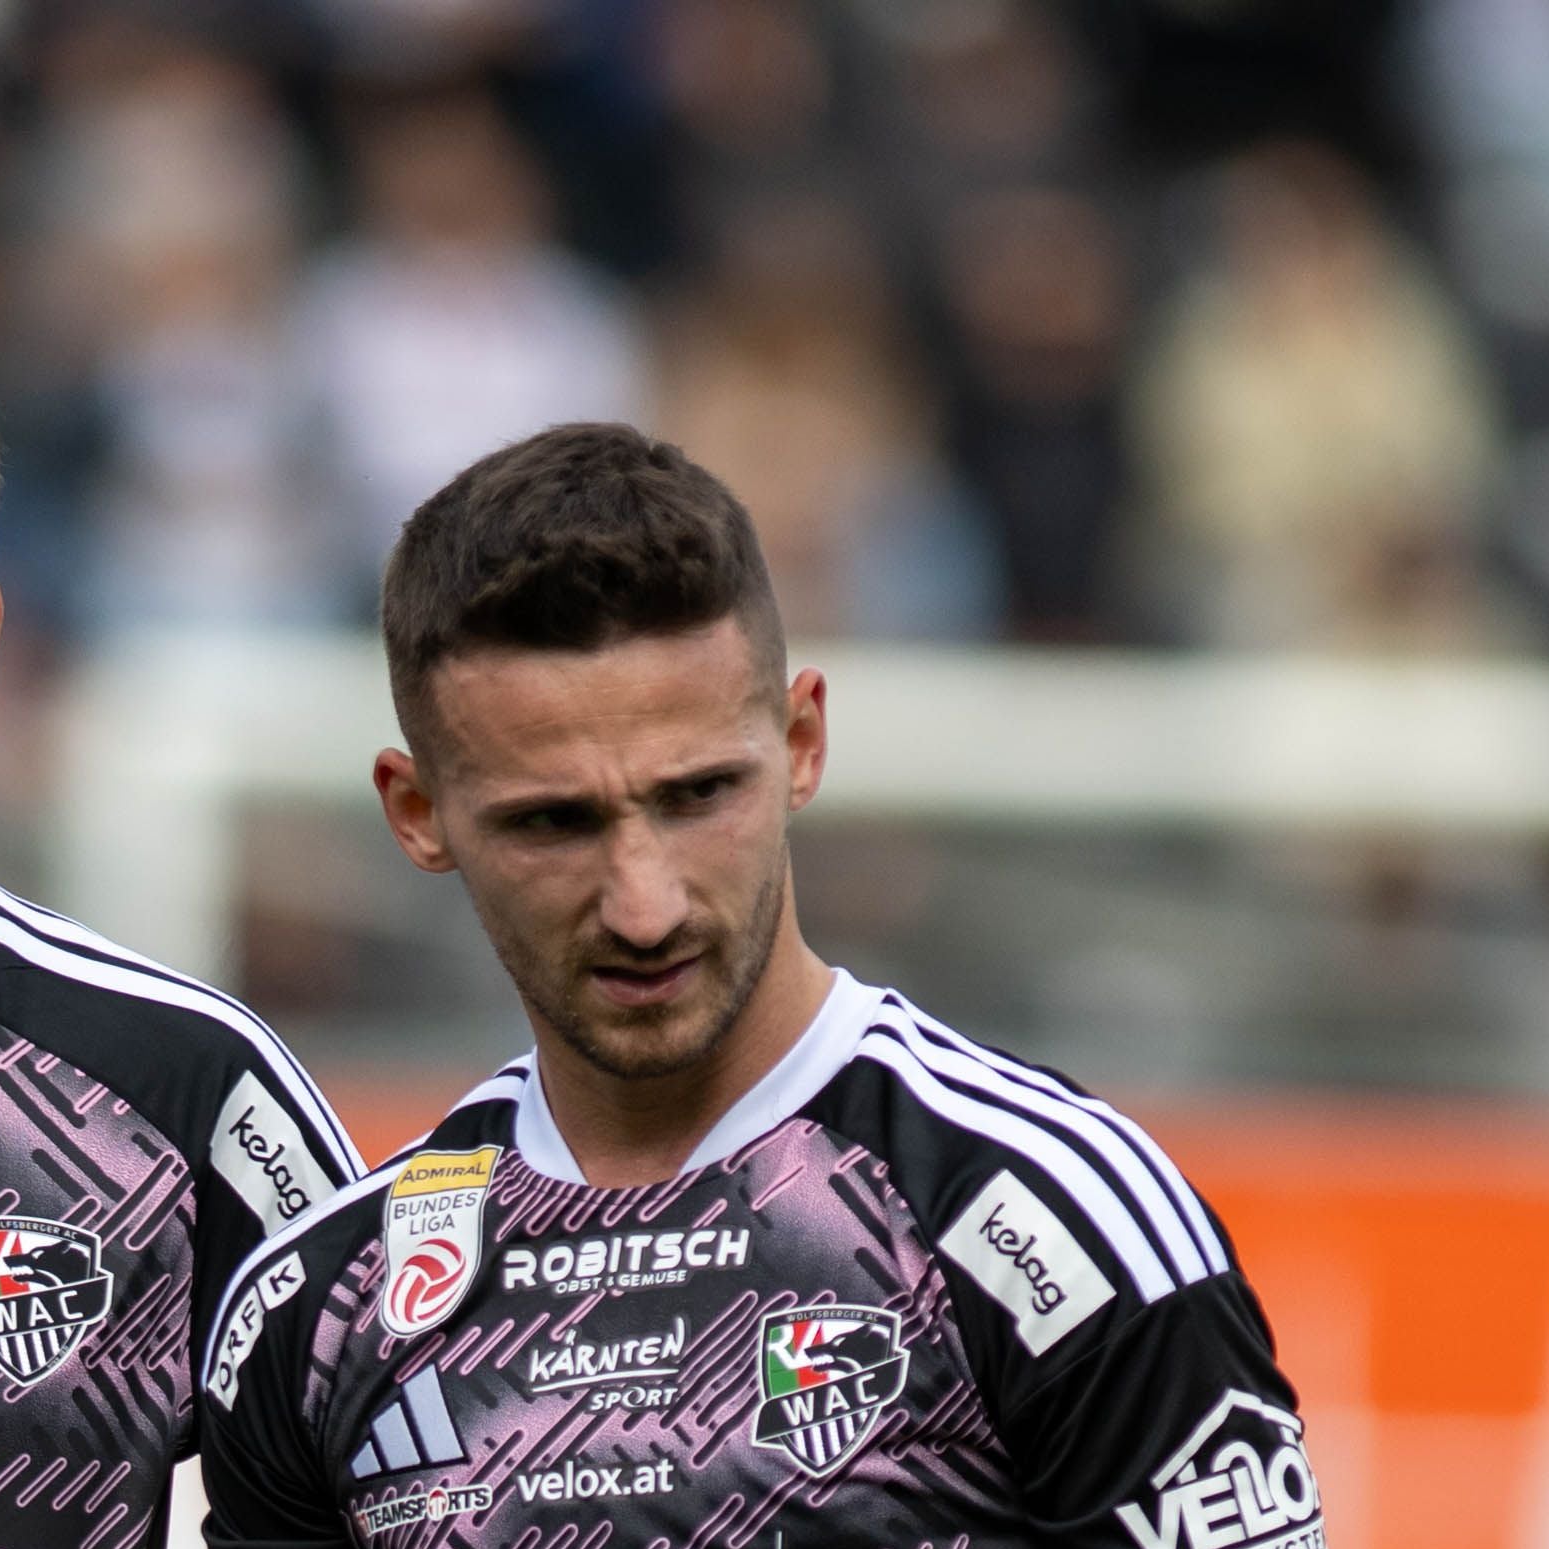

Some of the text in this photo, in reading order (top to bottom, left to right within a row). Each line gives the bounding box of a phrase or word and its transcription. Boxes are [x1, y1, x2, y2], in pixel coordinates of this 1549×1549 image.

[228, 1105, 311, 1221] kelag
[400, 1163, 487, 1185] ADMIRAL
[393, 1192, 479, 1220] BUNDES
[409, 1213, 455, 1236] LIGA
[504, 1229, 750, 1289] ROBITSCH
[981, 1202, 1067, 1314] kelag
[555, 1277, 601, 1294] OBST
[530, 1318, 685, 1382] KÄRNTEN
[590, 1387, 678, 1410] SPORT
[782, 1373, 879, 1426] WAC
[517, 1459, 674, 1501] velox.at
